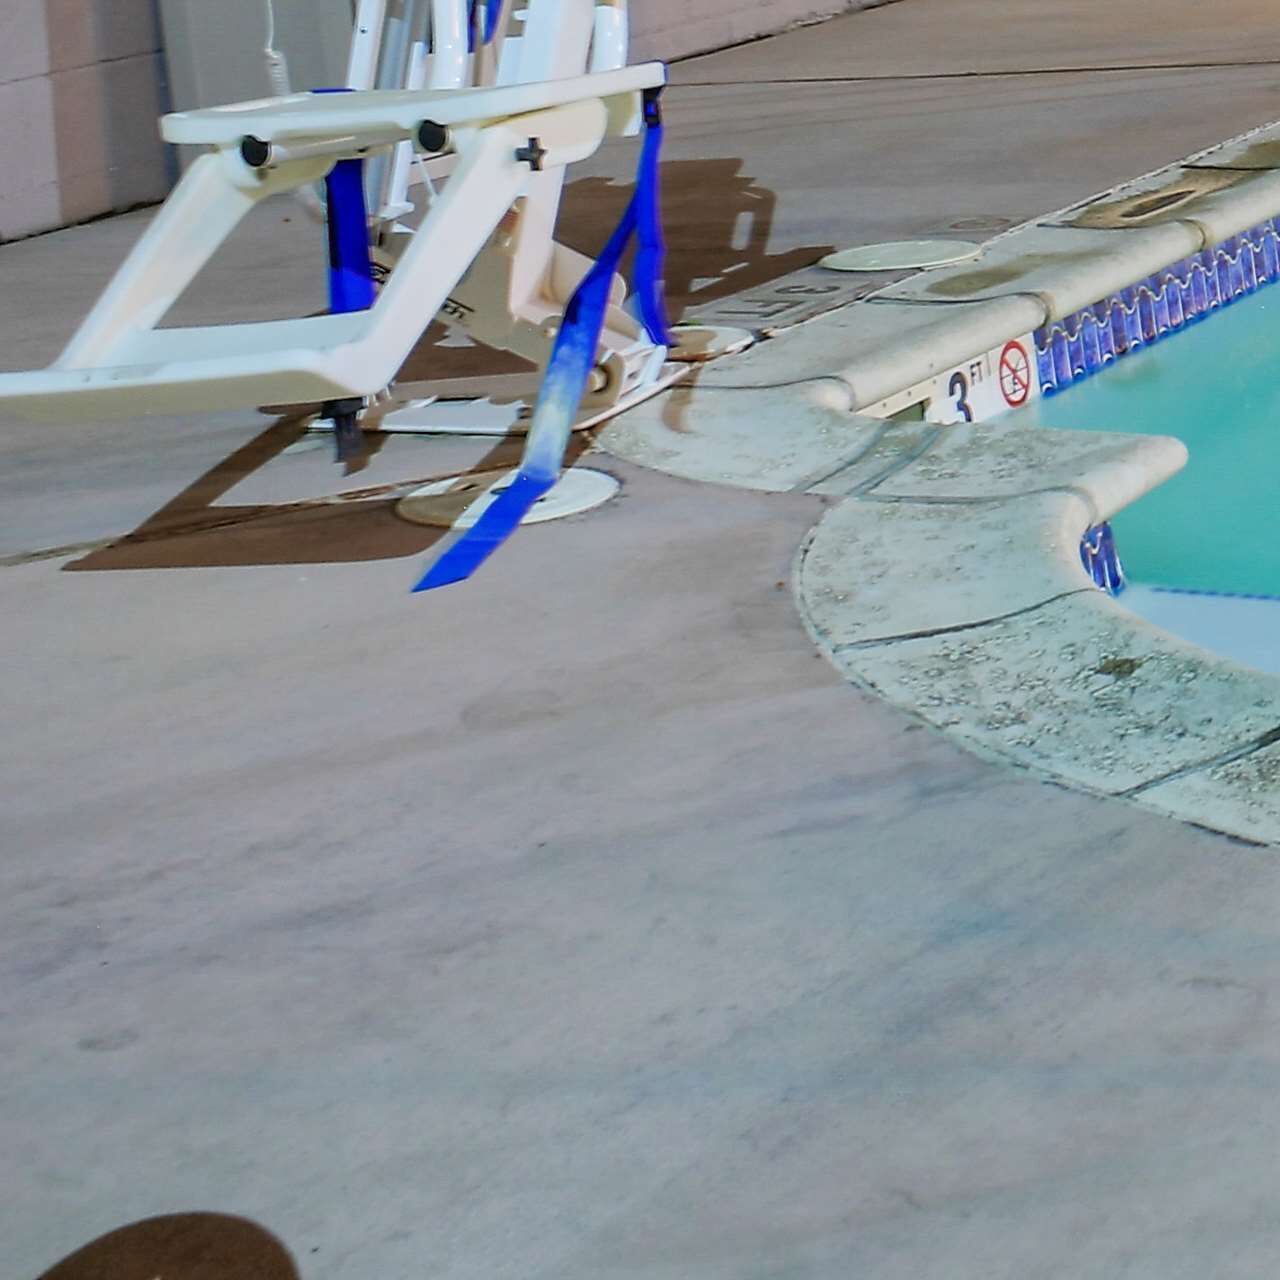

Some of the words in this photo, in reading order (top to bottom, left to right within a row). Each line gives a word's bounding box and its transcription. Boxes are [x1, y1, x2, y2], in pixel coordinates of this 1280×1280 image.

[775, 285, 841, 295] 3
[716, 299, 806, 318] FT
[949, 371, 972, 423] 3
[970, 362, 983, 386] FT
